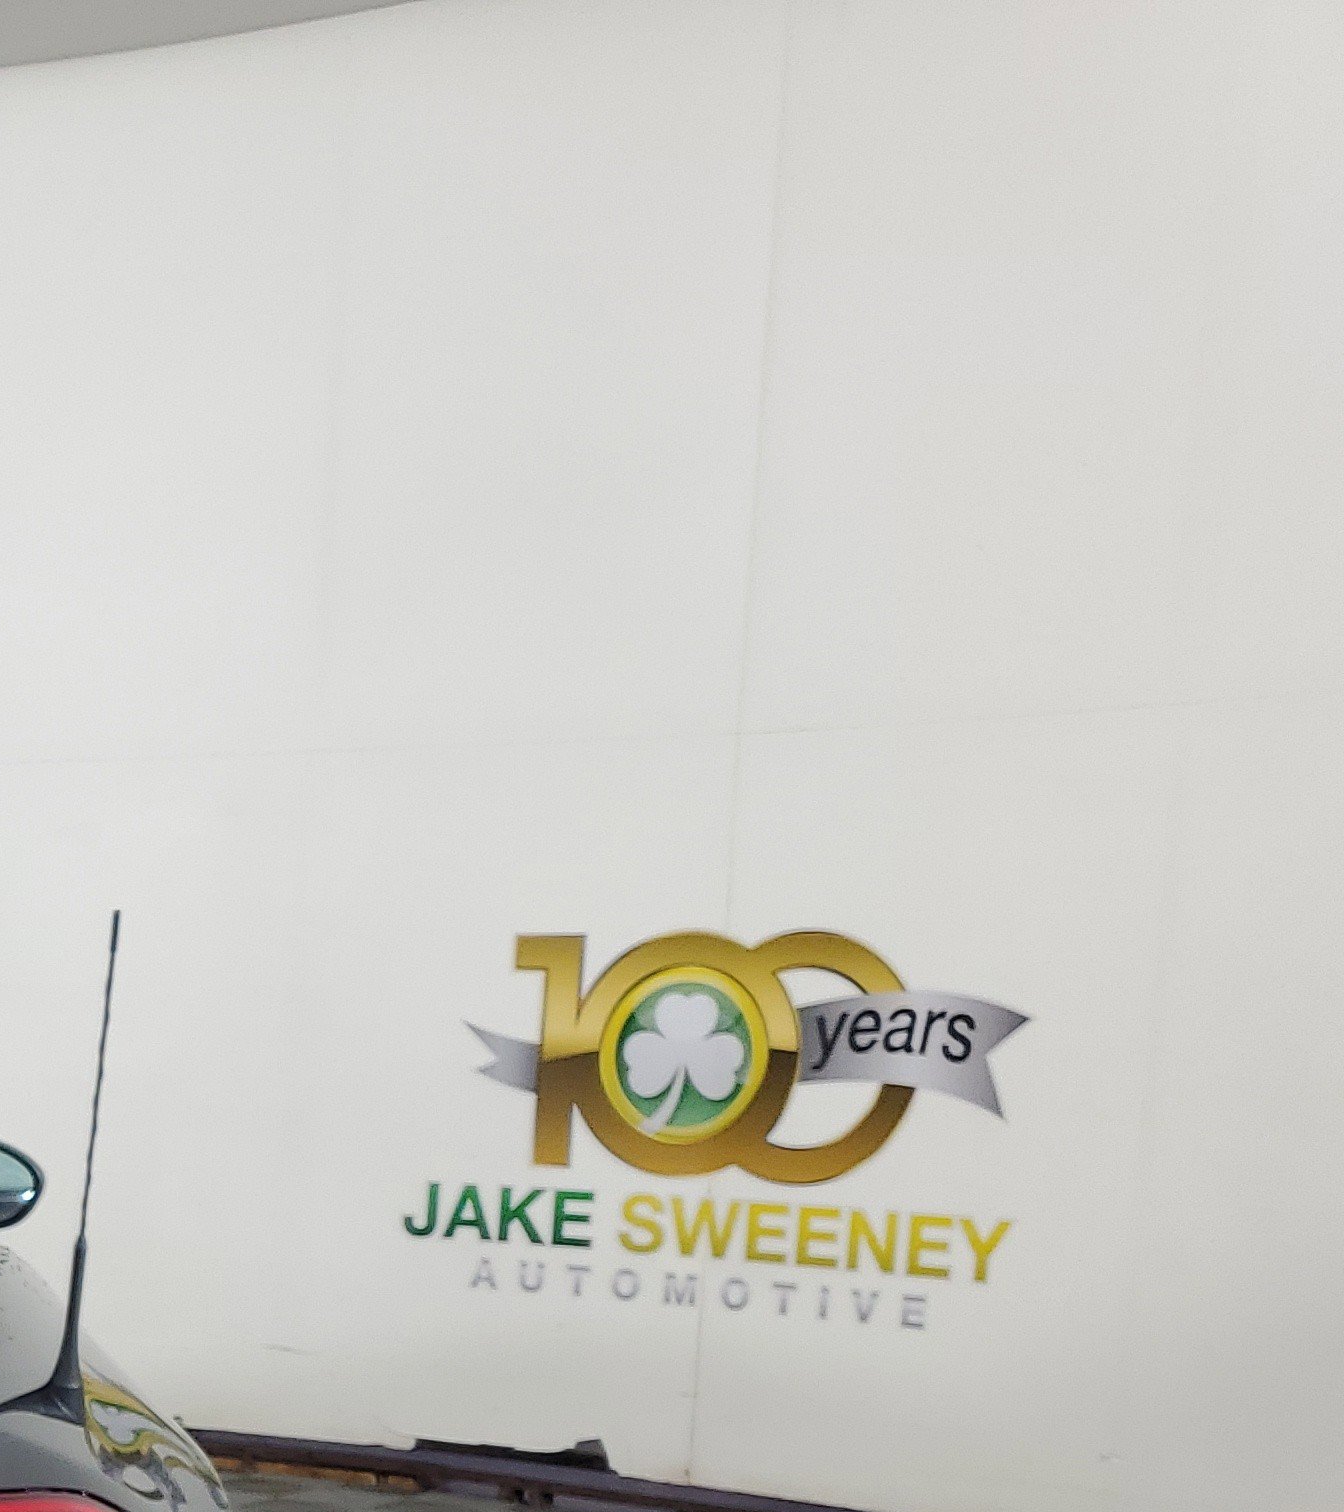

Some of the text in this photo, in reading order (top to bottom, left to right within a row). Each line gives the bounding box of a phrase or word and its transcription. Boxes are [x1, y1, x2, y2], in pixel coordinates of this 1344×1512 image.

[810, 1006, 977, 1072] years
[404, 1182, 1012, 1284] JAKE SWEENEY
[470, 1257, 927, 1331] AUTOMOTIVE
